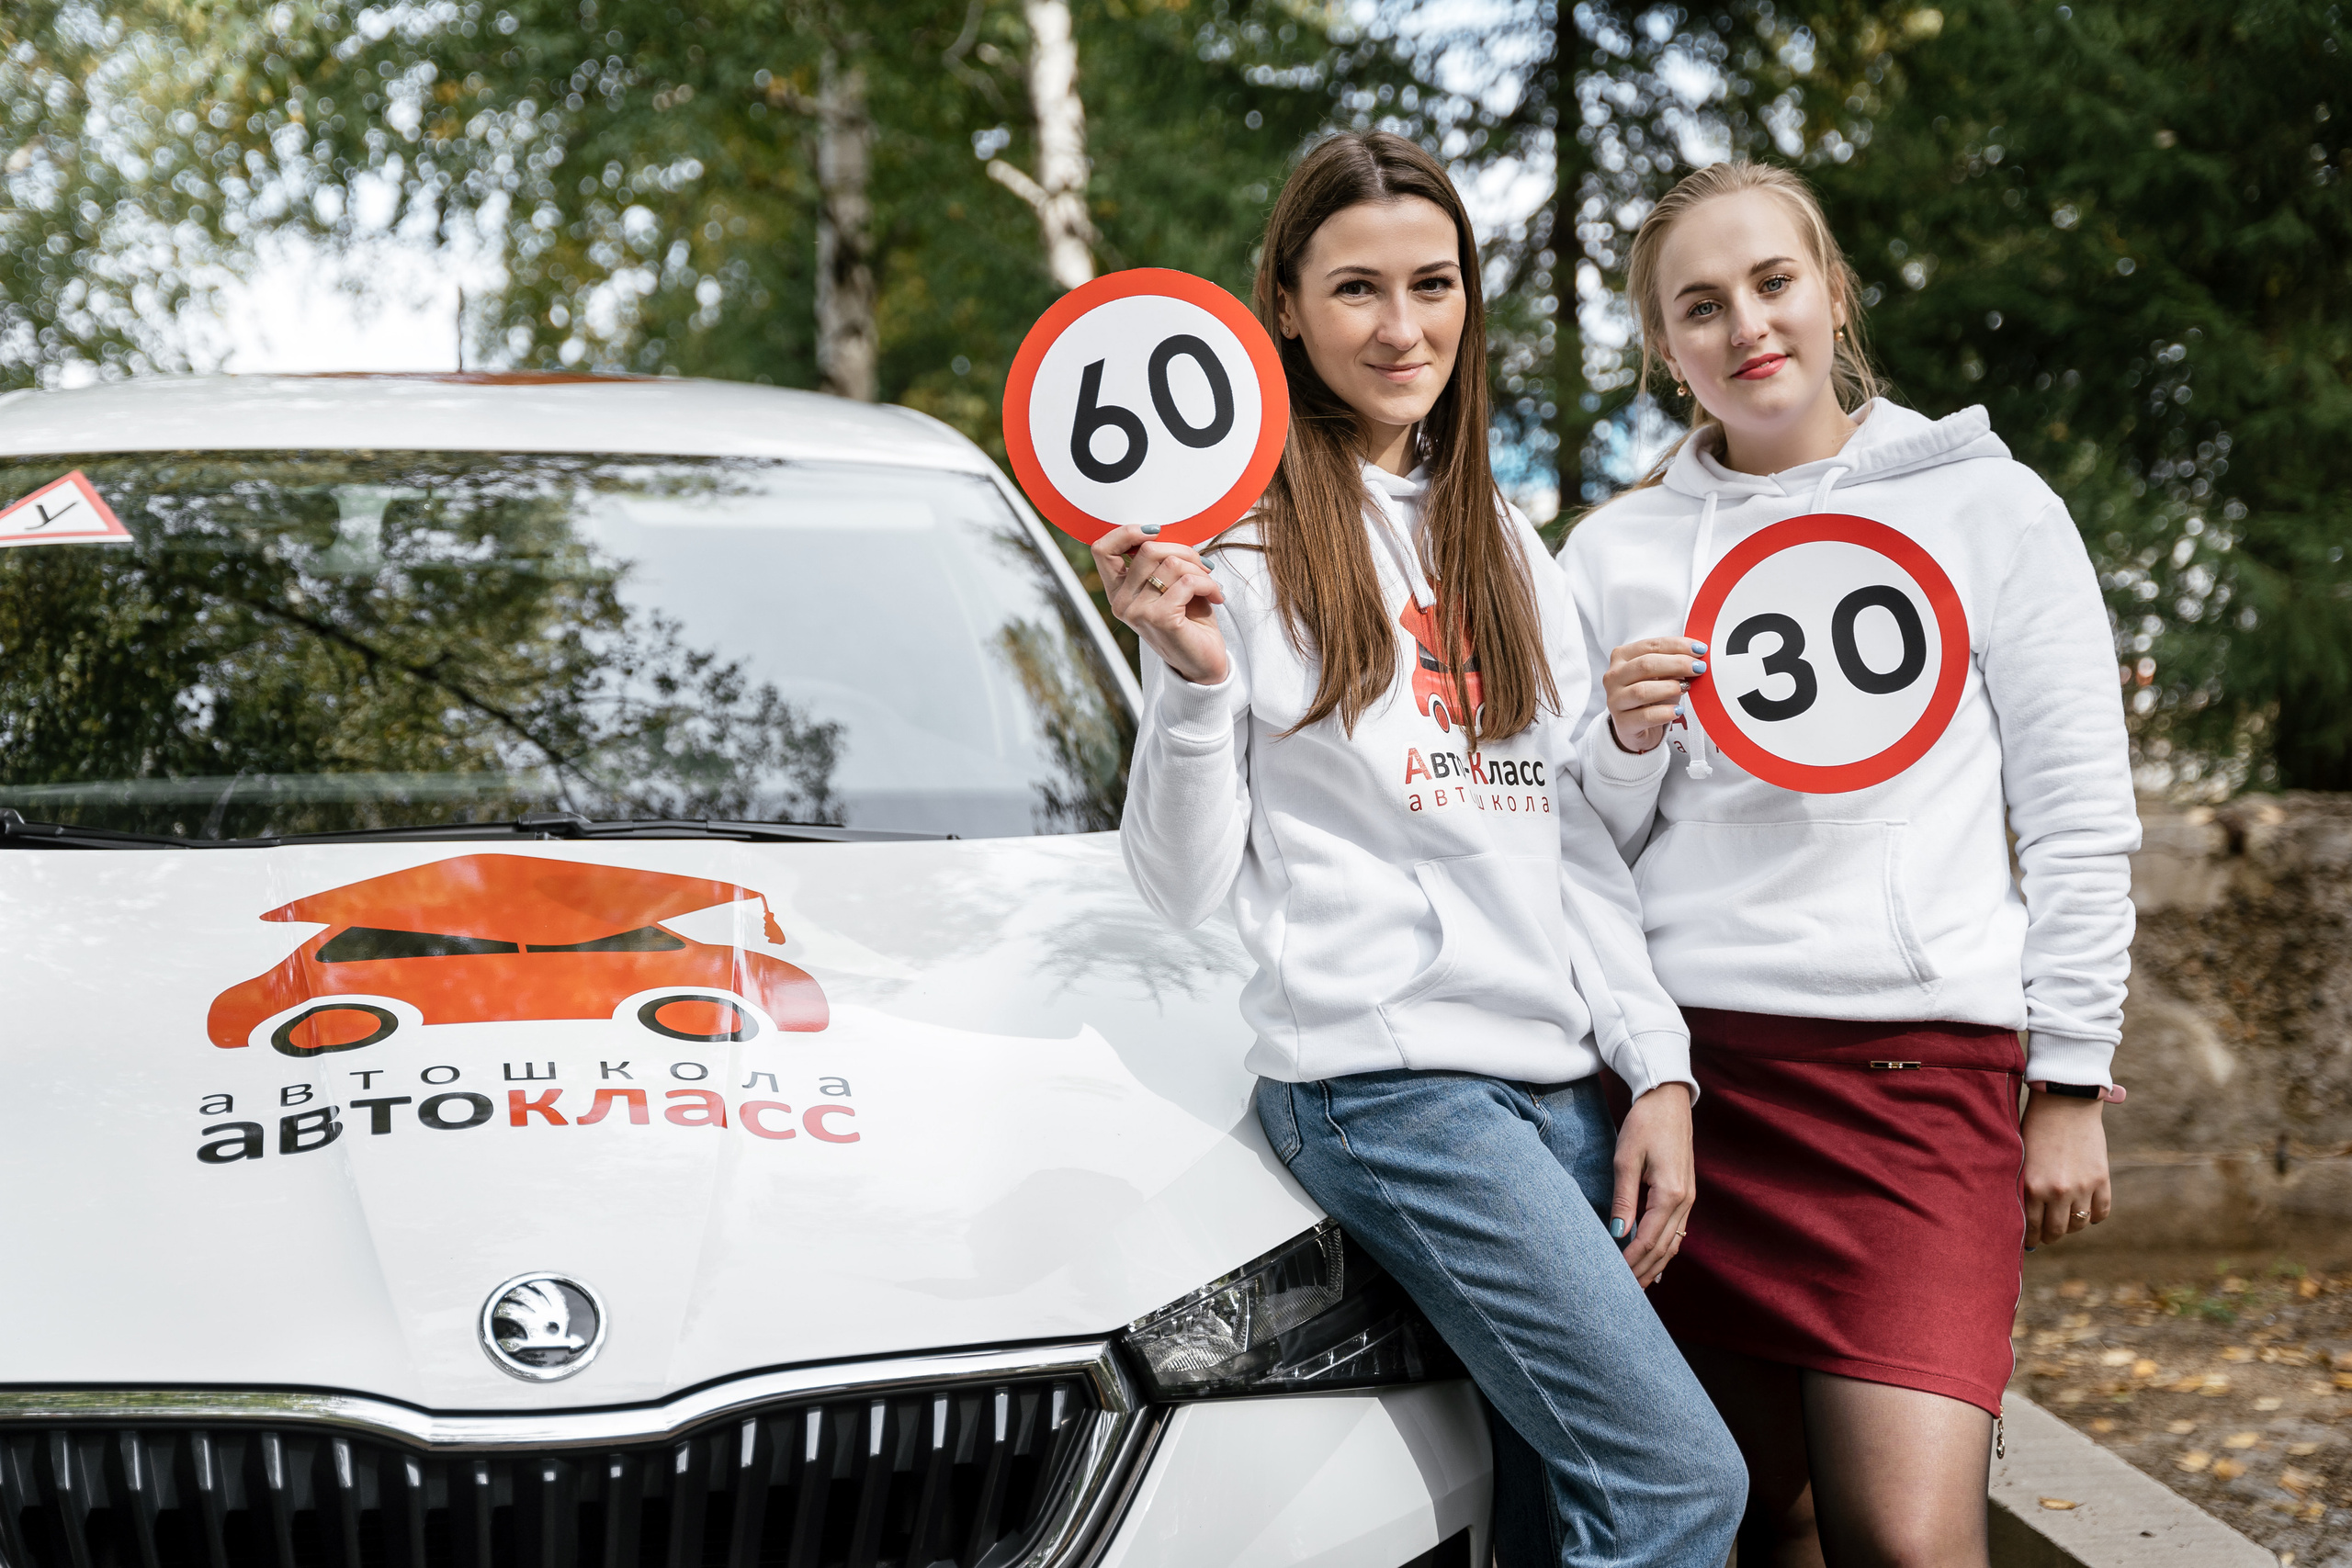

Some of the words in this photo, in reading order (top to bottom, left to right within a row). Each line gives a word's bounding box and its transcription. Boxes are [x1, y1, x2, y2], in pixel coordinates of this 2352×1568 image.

[1070, 333, 1235, 484] 60
[1725, 584, 1927, 722] 30
[1408, 786, 1550, 813] автшкола
[196, 1088, 861, 1165] автокласс
